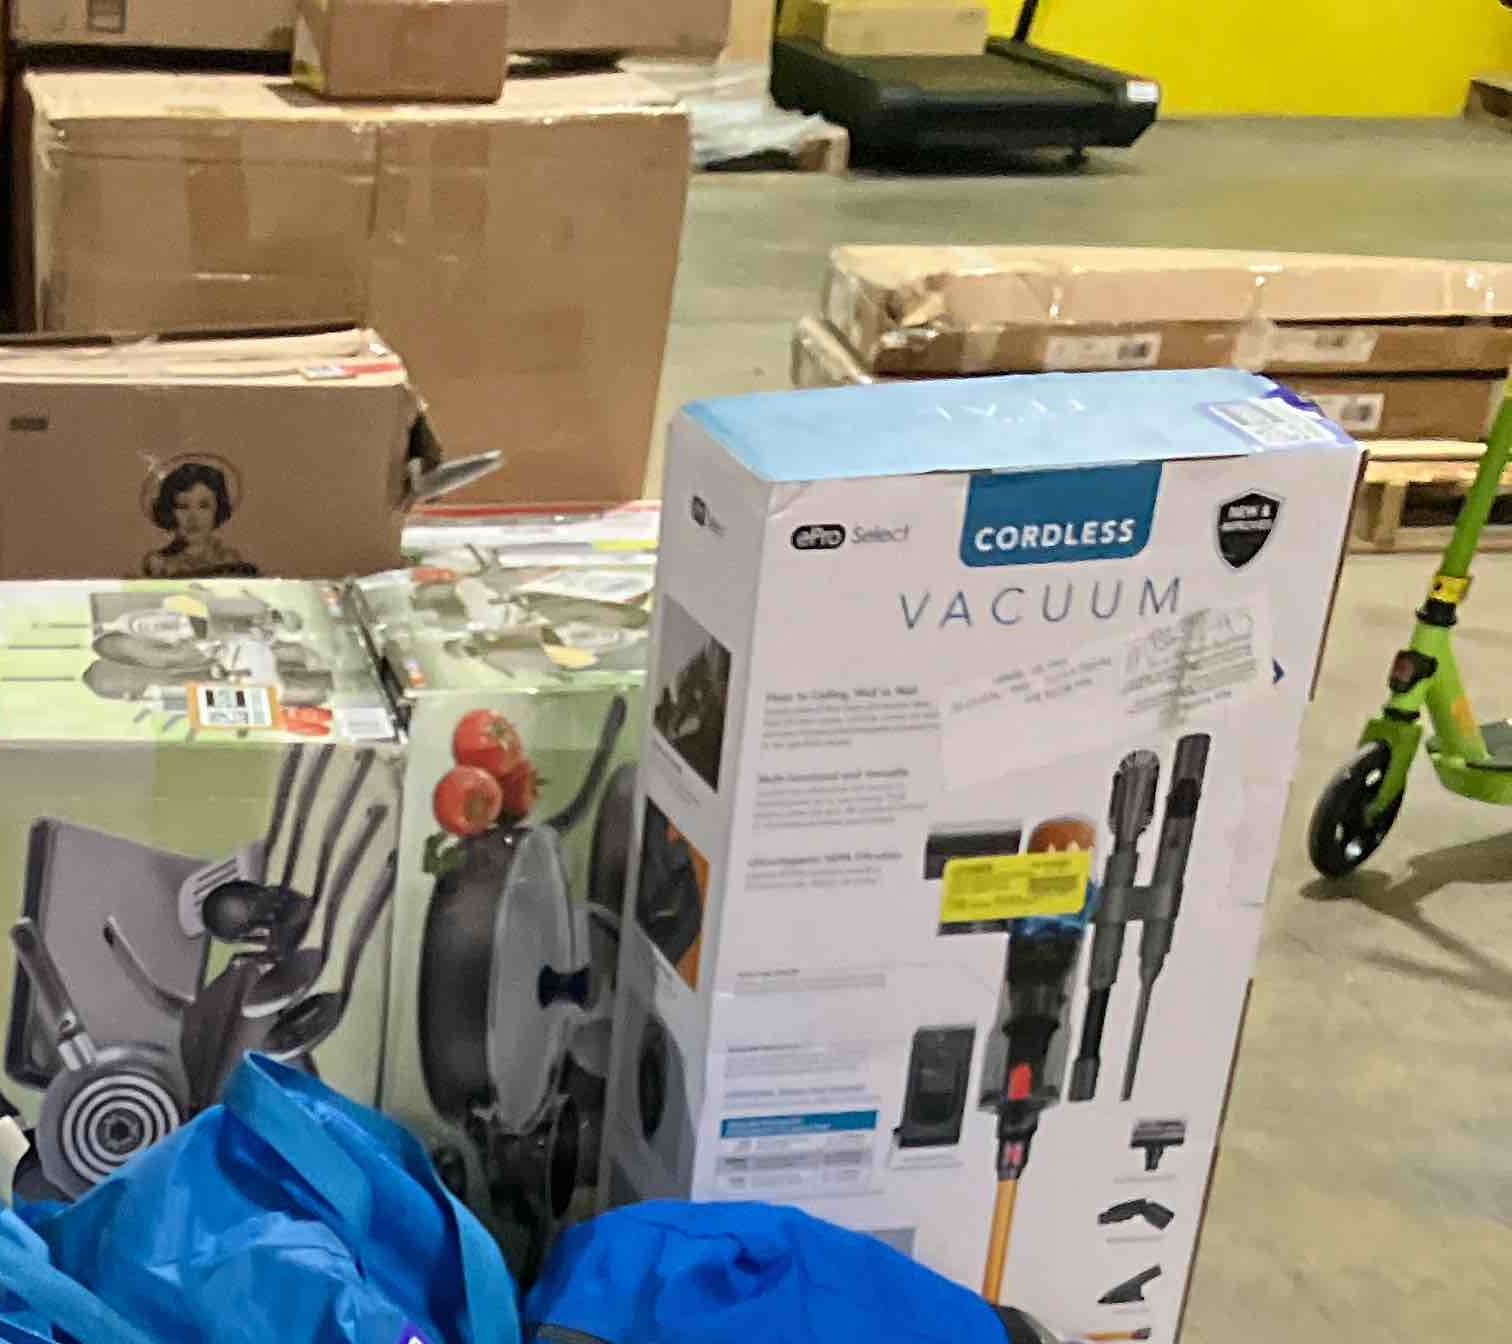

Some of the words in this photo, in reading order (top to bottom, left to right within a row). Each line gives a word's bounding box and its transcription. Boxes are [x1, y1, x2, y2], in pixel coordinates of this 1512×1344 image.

[850, 524, 911, 545] Select
[974, 518, 1137, 552] CORDLESS
[899, 575, 1182, 630] VACUUM
